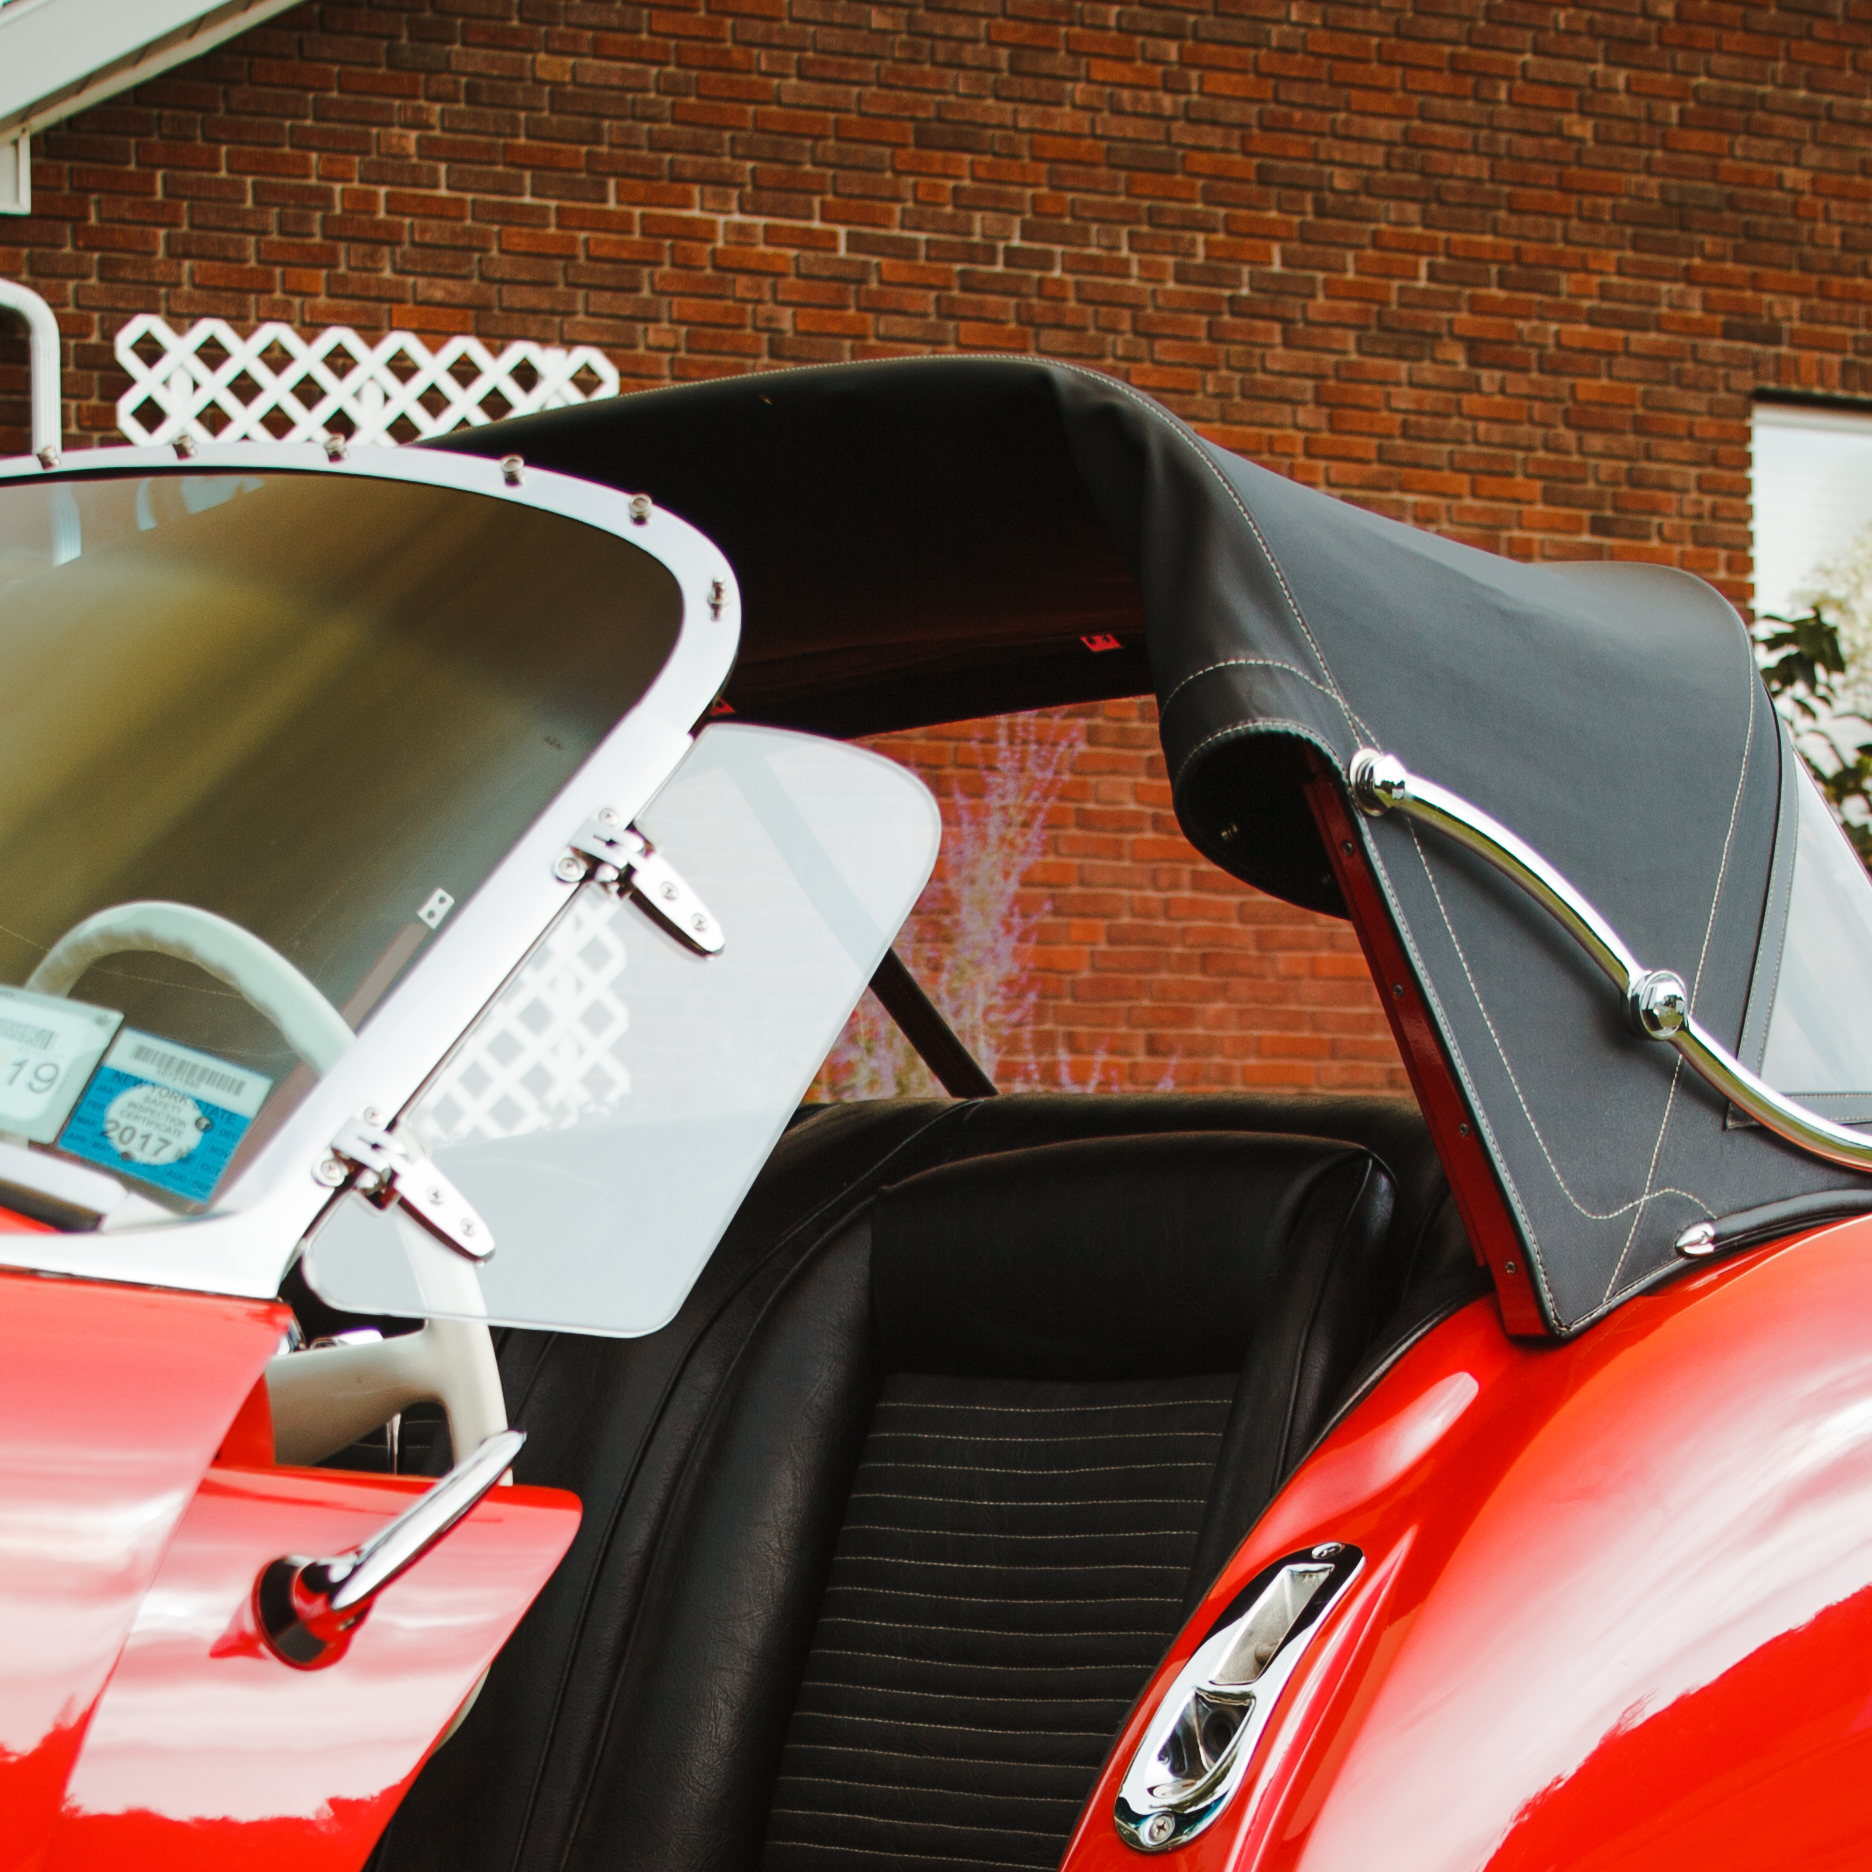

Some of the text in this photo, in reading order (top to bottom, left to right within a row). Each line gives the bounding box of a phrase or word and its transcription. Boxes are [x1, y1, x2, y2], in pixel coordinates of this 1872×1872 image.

[7, 1058, 60, 1094] 19
[95, 1083, 116, 1096] JAN
[113, 1070, 237, 1126] NEW YORK STATE
[143, 1095, 182, 1114] SAFETY
[76, 1114, 99, 1128] MAR
[127, 1100, 188, 1128] INSPECTION
[119, 1109, 183, 1138] CERTIFICATE
[102, 1119, 173, 1158] 2017
[218, 1128, 239, 1142] DEC
[91, 1140, 112, 1153] MAY
[209, 1145, 230, 1159] NOV
[165, 1169, 188, 1184] AUG
[200, 1162, 221, 1176] OCT
